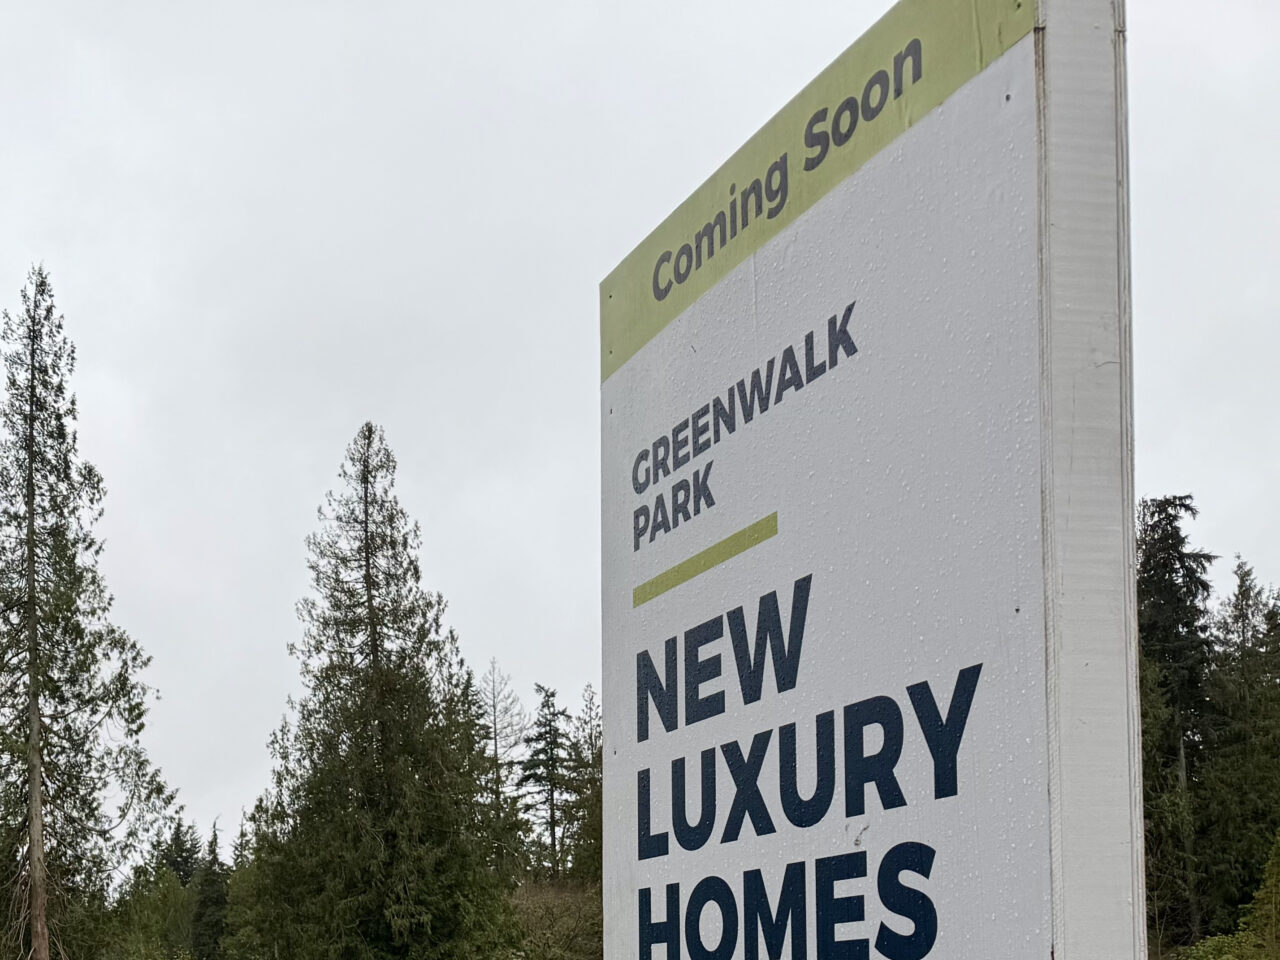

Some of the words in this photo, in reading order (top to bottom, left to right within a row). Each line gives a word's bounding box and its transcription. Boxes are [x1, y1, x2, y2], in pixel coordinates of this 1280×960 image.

[652, 152, 789, 302] Coming
[803, 38, 922, 172] Soon
[631, 301, 858, 494] GREENWALK
[633, 460, 716, 552] PARK
[636, 573, 813, 743] NEW
[637, 662, 983, 861] LUXURY
